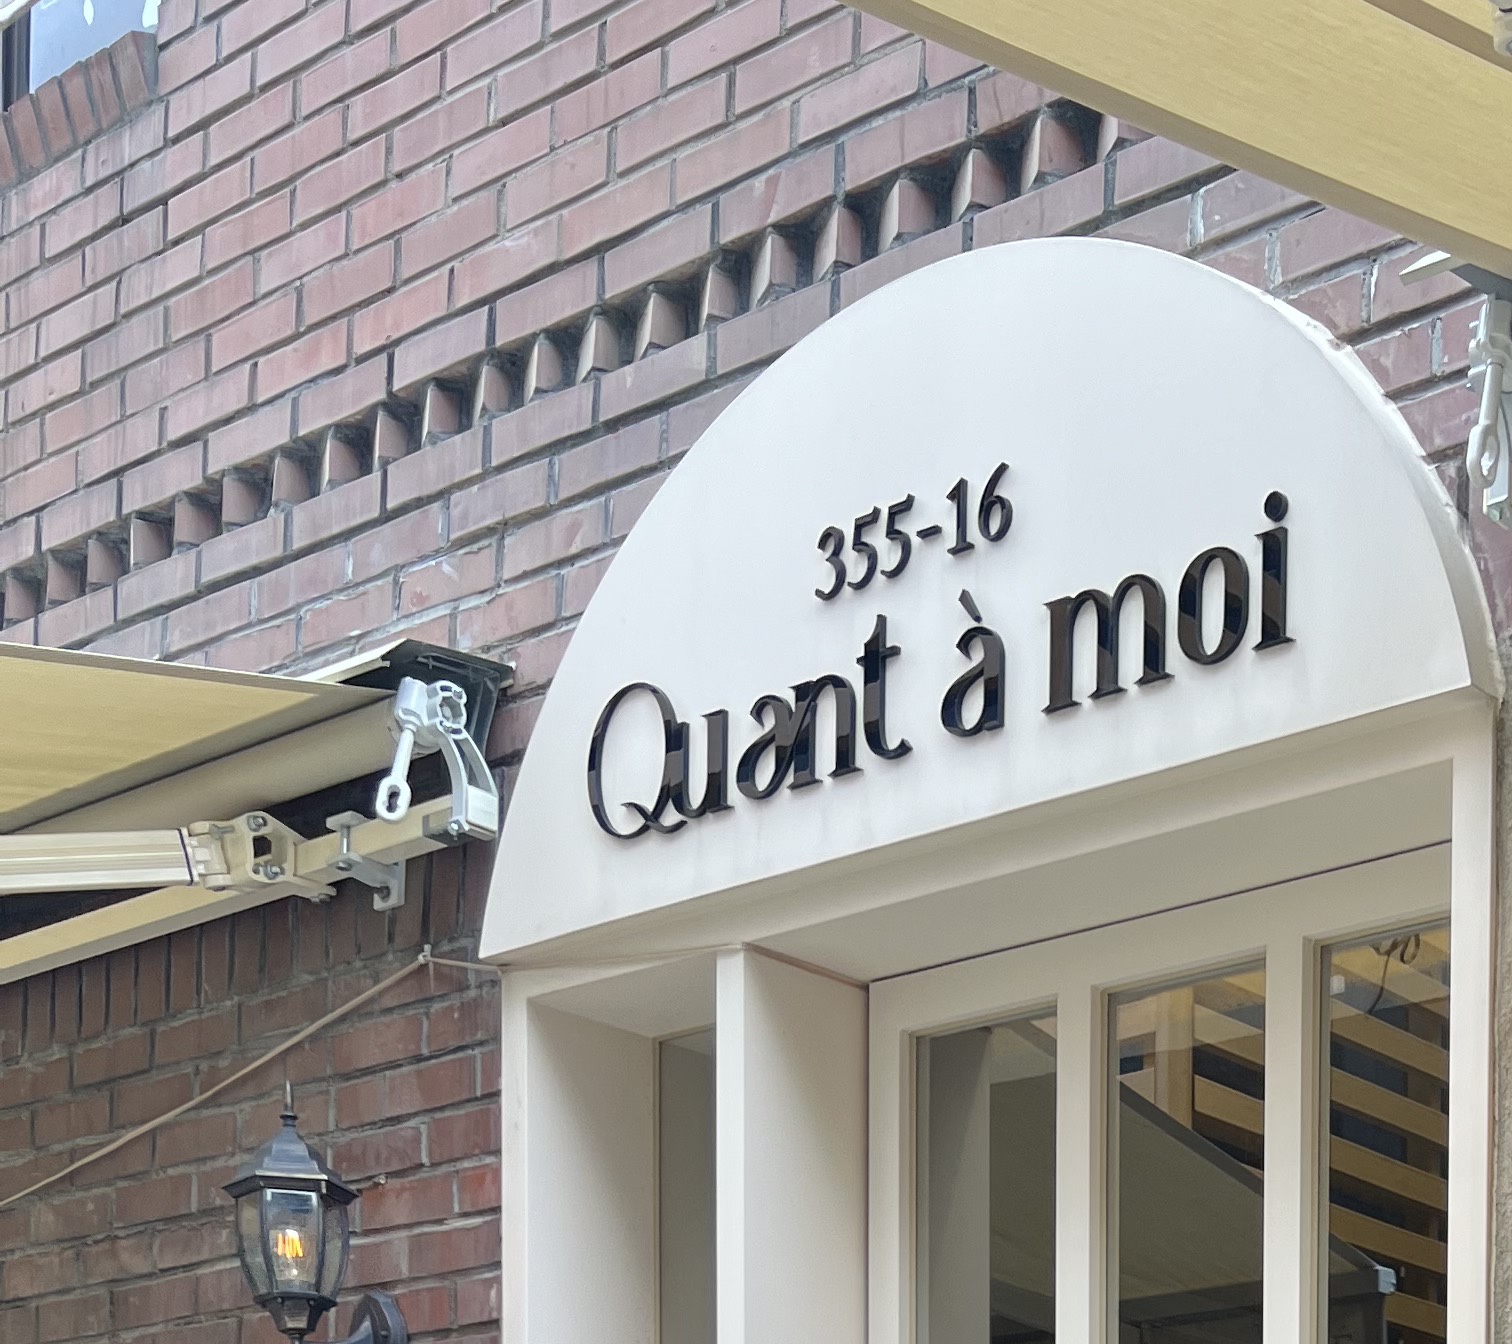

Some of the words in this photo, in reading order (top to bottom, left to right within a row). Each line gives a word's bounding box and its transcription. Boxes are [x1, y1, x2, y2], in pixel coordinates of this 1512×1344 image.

[815, 462, 1013, 602] 355-16
[587, 613, 914, 841] Quant
[940, 588, 1007, 738] à
[1041, 490, 1296, 718] moi
